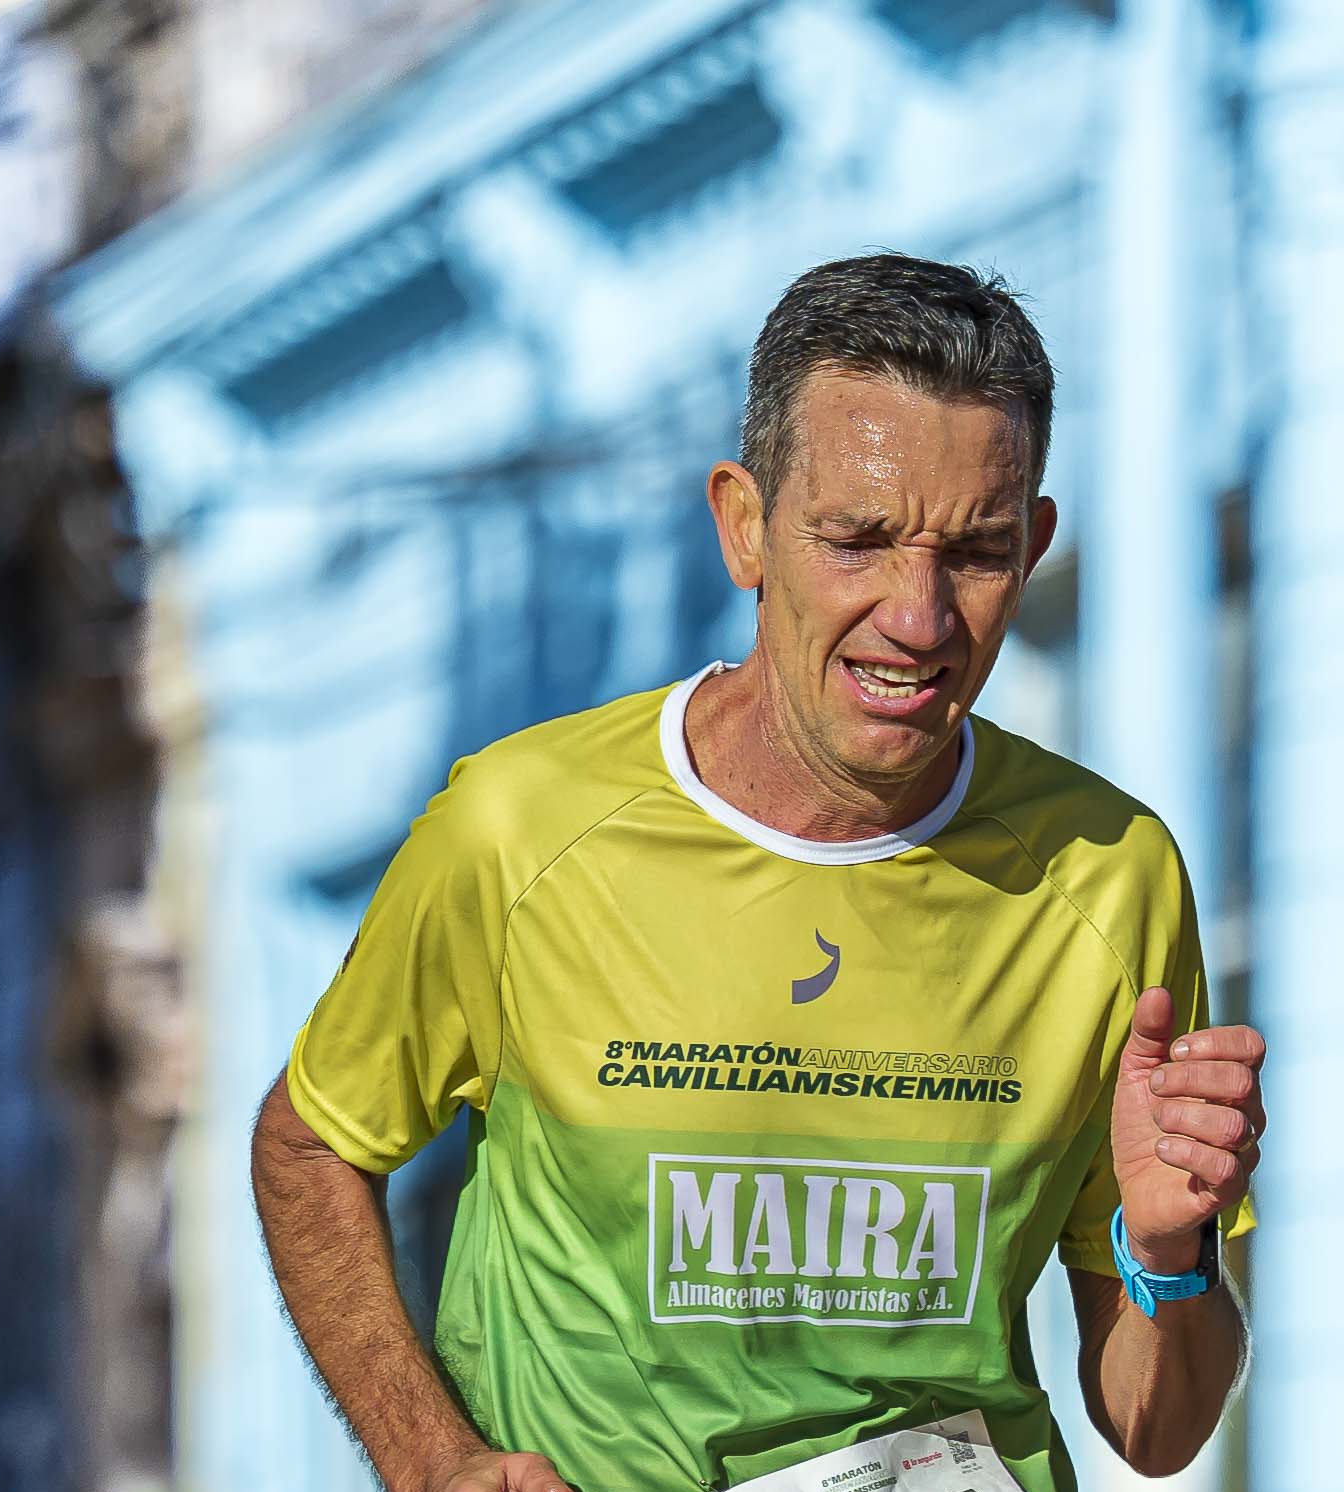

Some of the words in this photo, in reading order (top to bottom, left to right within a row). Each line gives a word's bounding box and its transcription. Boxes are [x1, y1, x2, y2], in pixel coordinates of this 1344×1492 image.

[597, 1062, 1024, 1103] CAWILLIAMSKEMMIS
[668, 1171, 958, 1279] MAIRA
[667, 1280, 785, 1310] Almacenes
[792, 1283, 910, 1313] Mayoristas
[916, 1287, 954, 1312] S.A.
